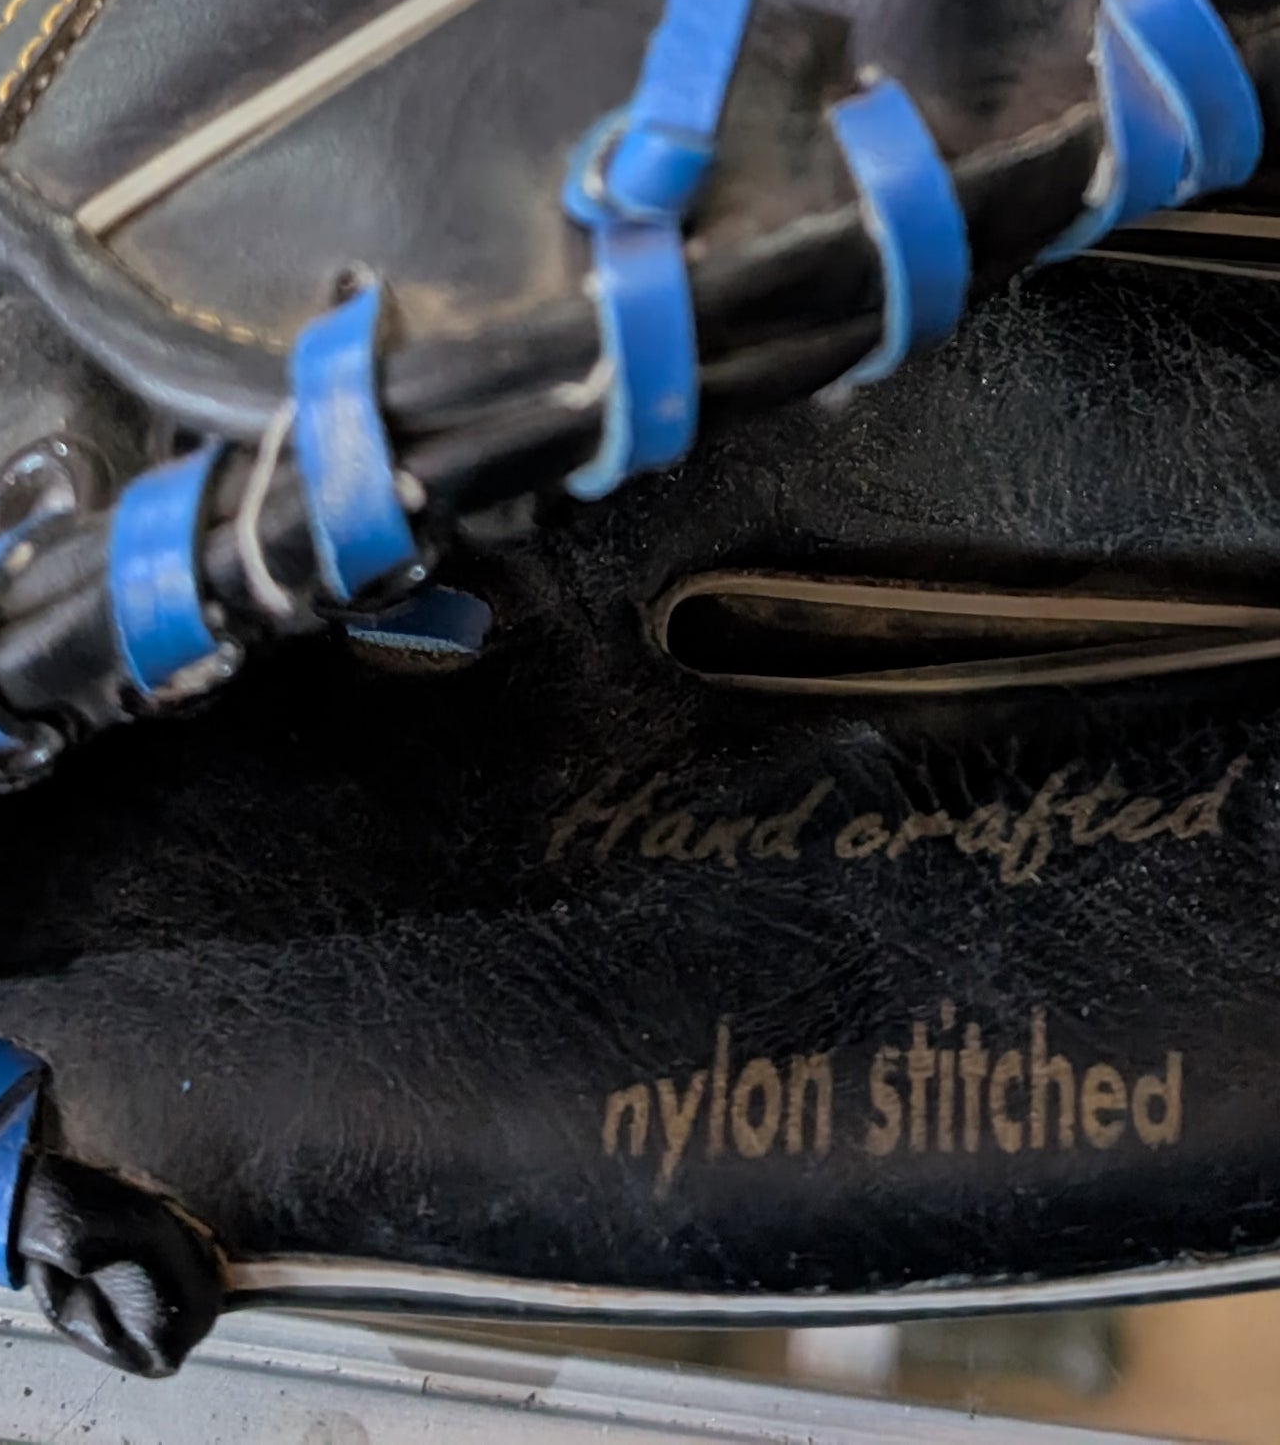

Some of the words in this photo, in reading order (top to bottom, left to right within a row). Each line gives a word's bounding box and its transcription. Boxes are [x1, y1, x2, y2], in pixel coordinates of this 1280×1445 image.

[546, 771, 834, 866] Hand
[835, 755, 1249, 885] crafted
[603, 1014, 832, 1200] nylon
[867, 998, 1183, 1153] stitched
